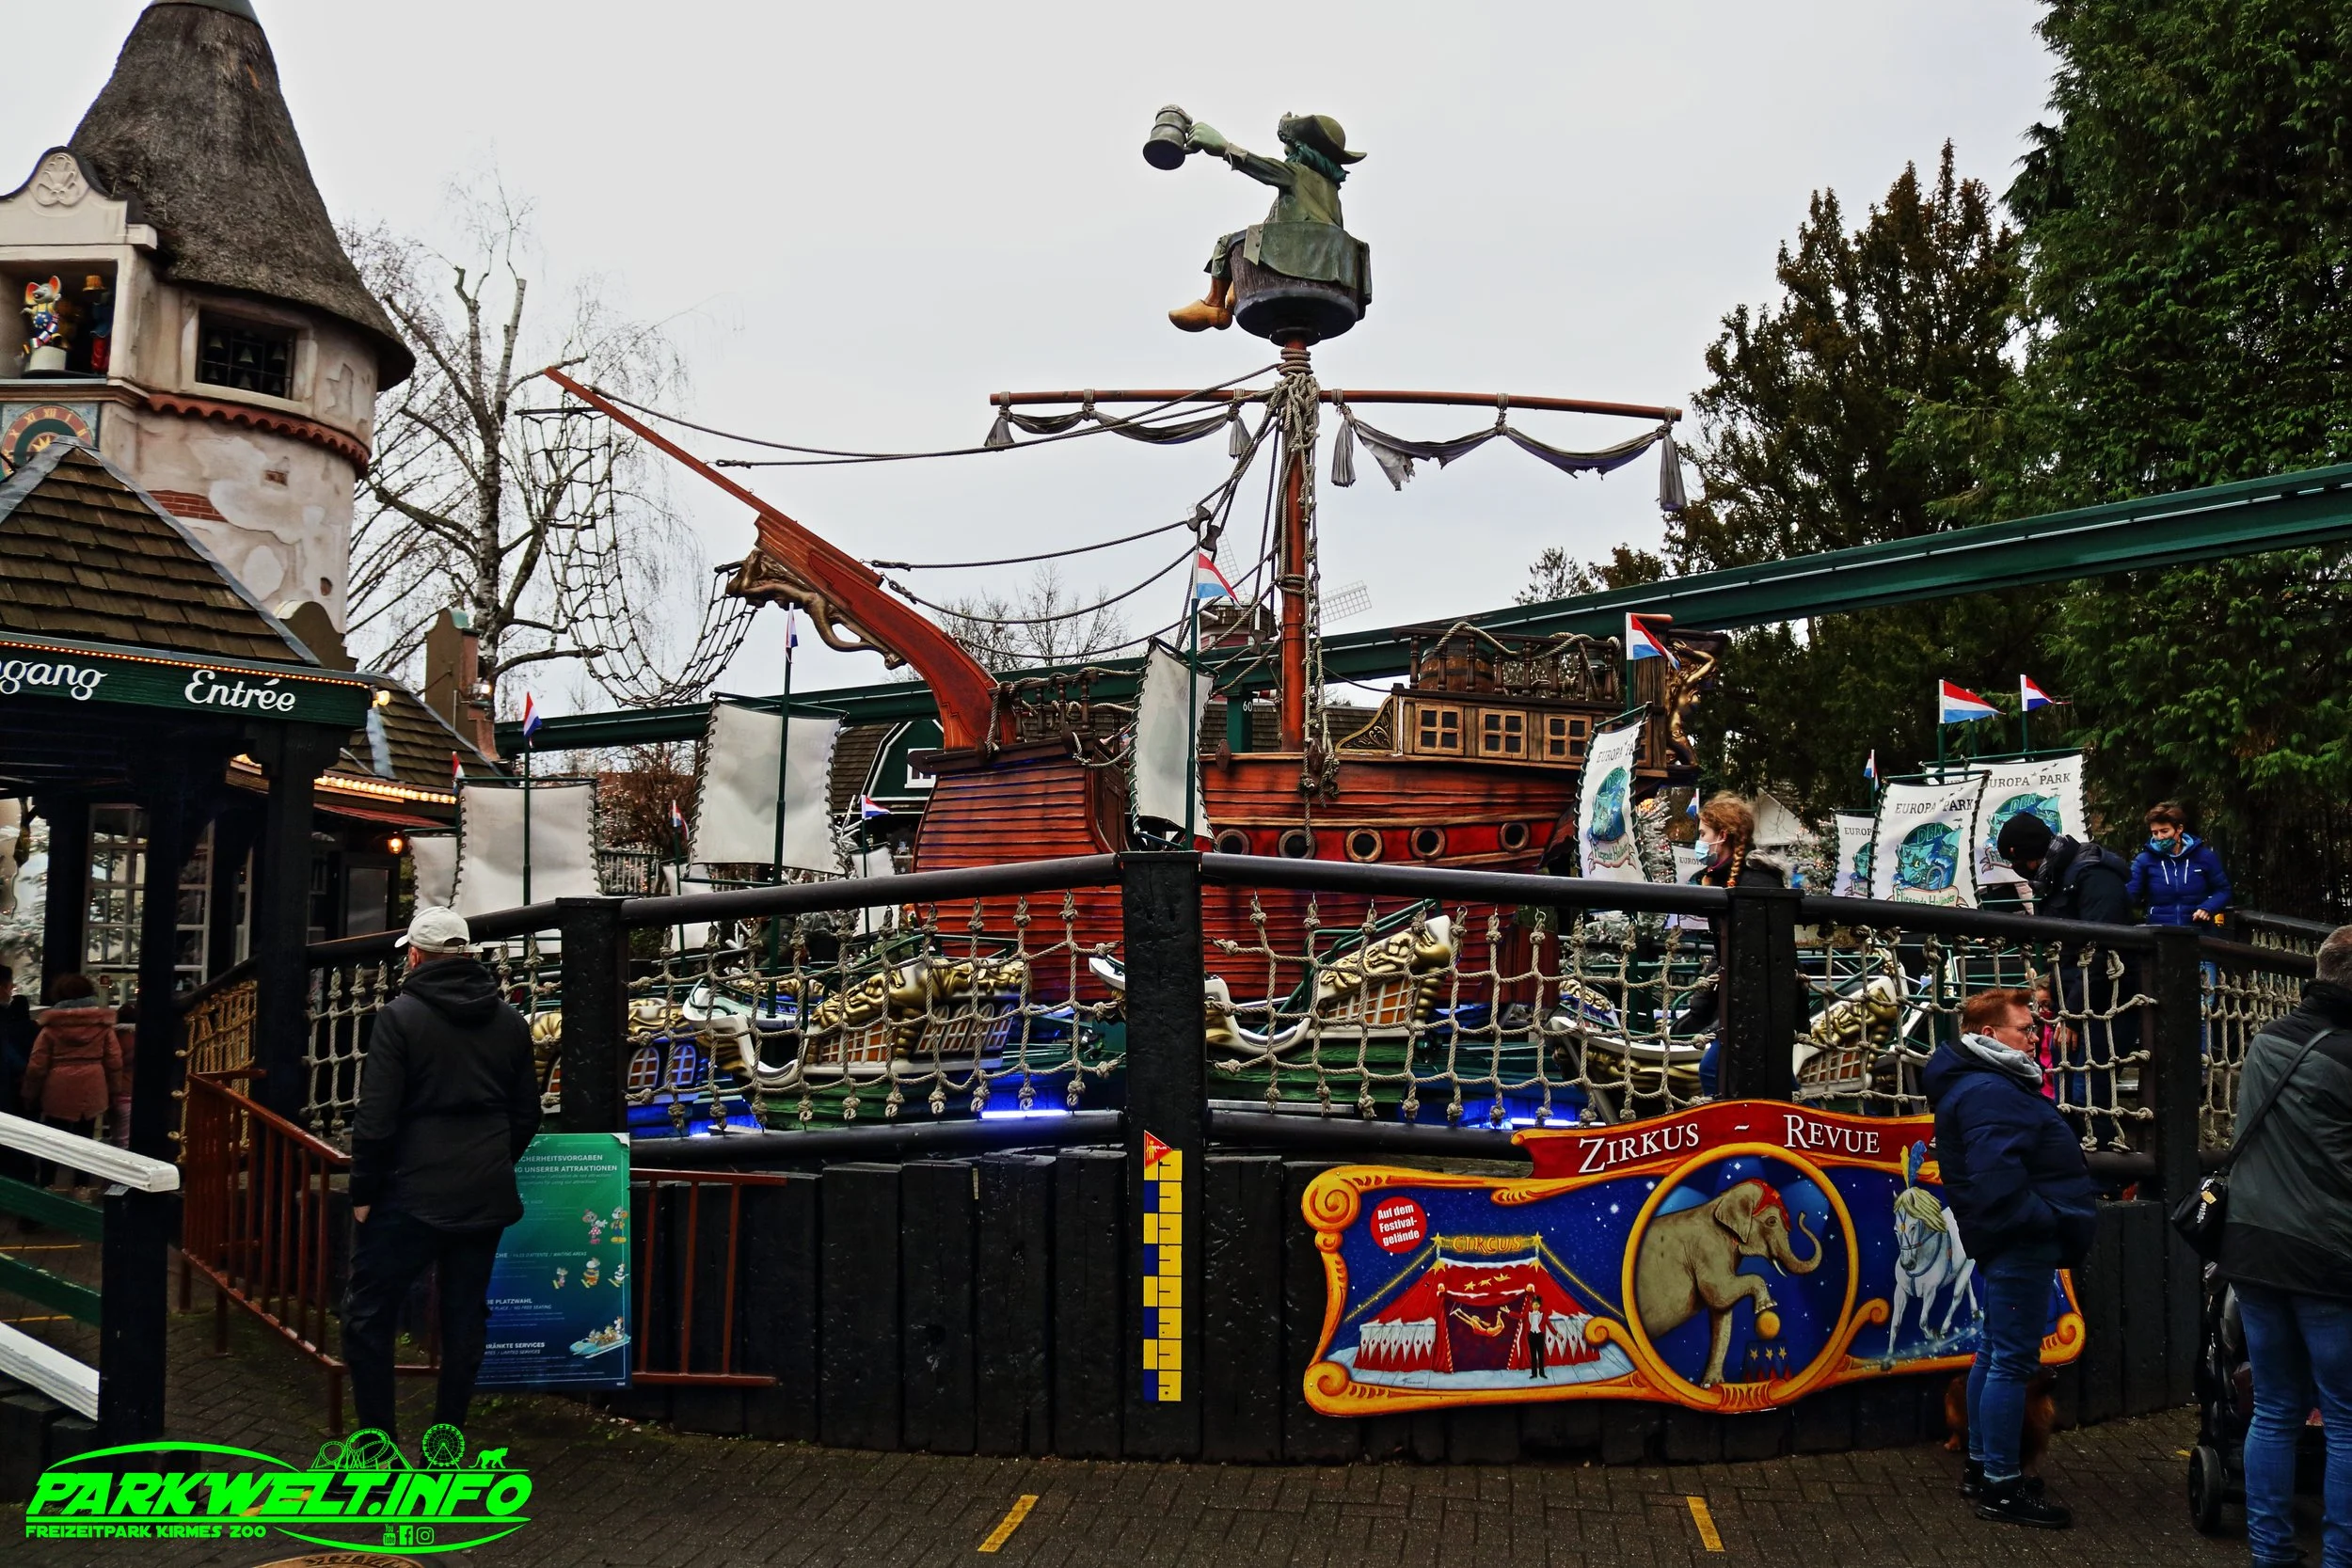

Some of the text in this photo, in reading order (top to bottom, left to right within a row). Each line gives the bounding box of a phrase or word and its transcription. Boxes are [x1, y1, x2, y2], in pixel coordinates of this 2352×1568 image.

[184, 669, 296, 712] Entrée
[1242, 700, 1252, 712] 60
[1986, 773, 2071, 788] UROPA PARK
[1895, 798, 1975, 815] EUROPA PARK
[2010, 793, 2038, 813] DER
[1916, 823, 1944, 844] DER
[1578, 1123, 1700, 1174] ZIRKUS
[1783, 1115, 1880, 1153] REVUE
[518, 1154, 603, 1163] CHERHEITSVORGABEN
[1377, 1204, 1414, 1221] Auf dem
[1379, 1216, 1418, 1233] Festival-
[1383, 1229, 1420, 1247] gelände
[1452, 1235, 1522, 1255] CIRCUS
